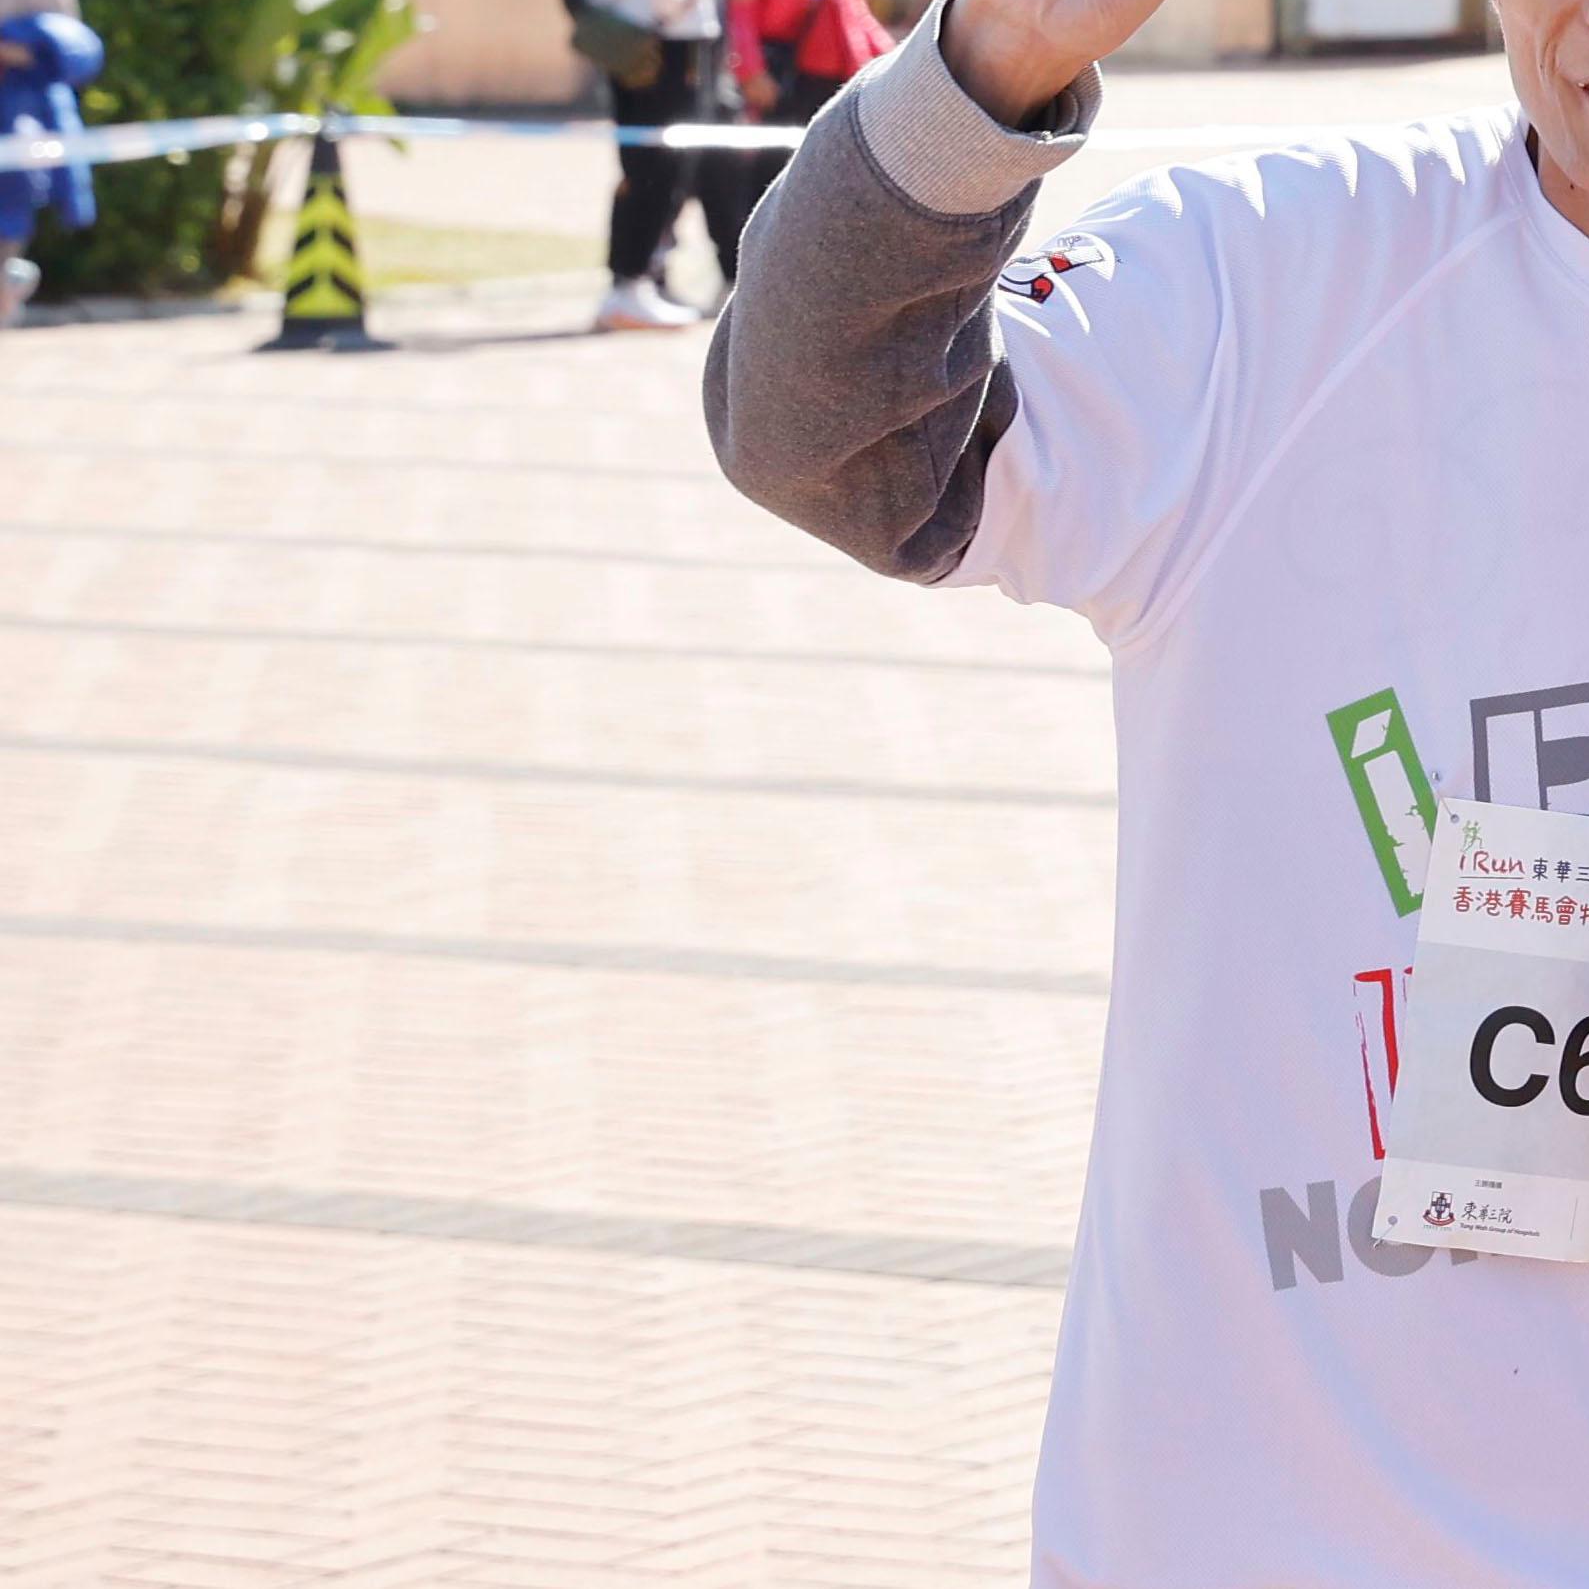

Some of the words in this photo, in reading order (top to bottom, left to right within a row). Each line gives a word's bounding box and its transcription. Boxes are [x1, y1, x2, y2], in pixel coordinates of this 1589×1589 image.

[1461, 1200, 1513, 1225] 東華三院
[1459, 1222, 1474, 1232] Tung
[1474, 1224, 1488, 1232] Wah
[1489, 1226, 1507, 1235] Group
[1514, 1228, 1541, 1238] Hospitals
